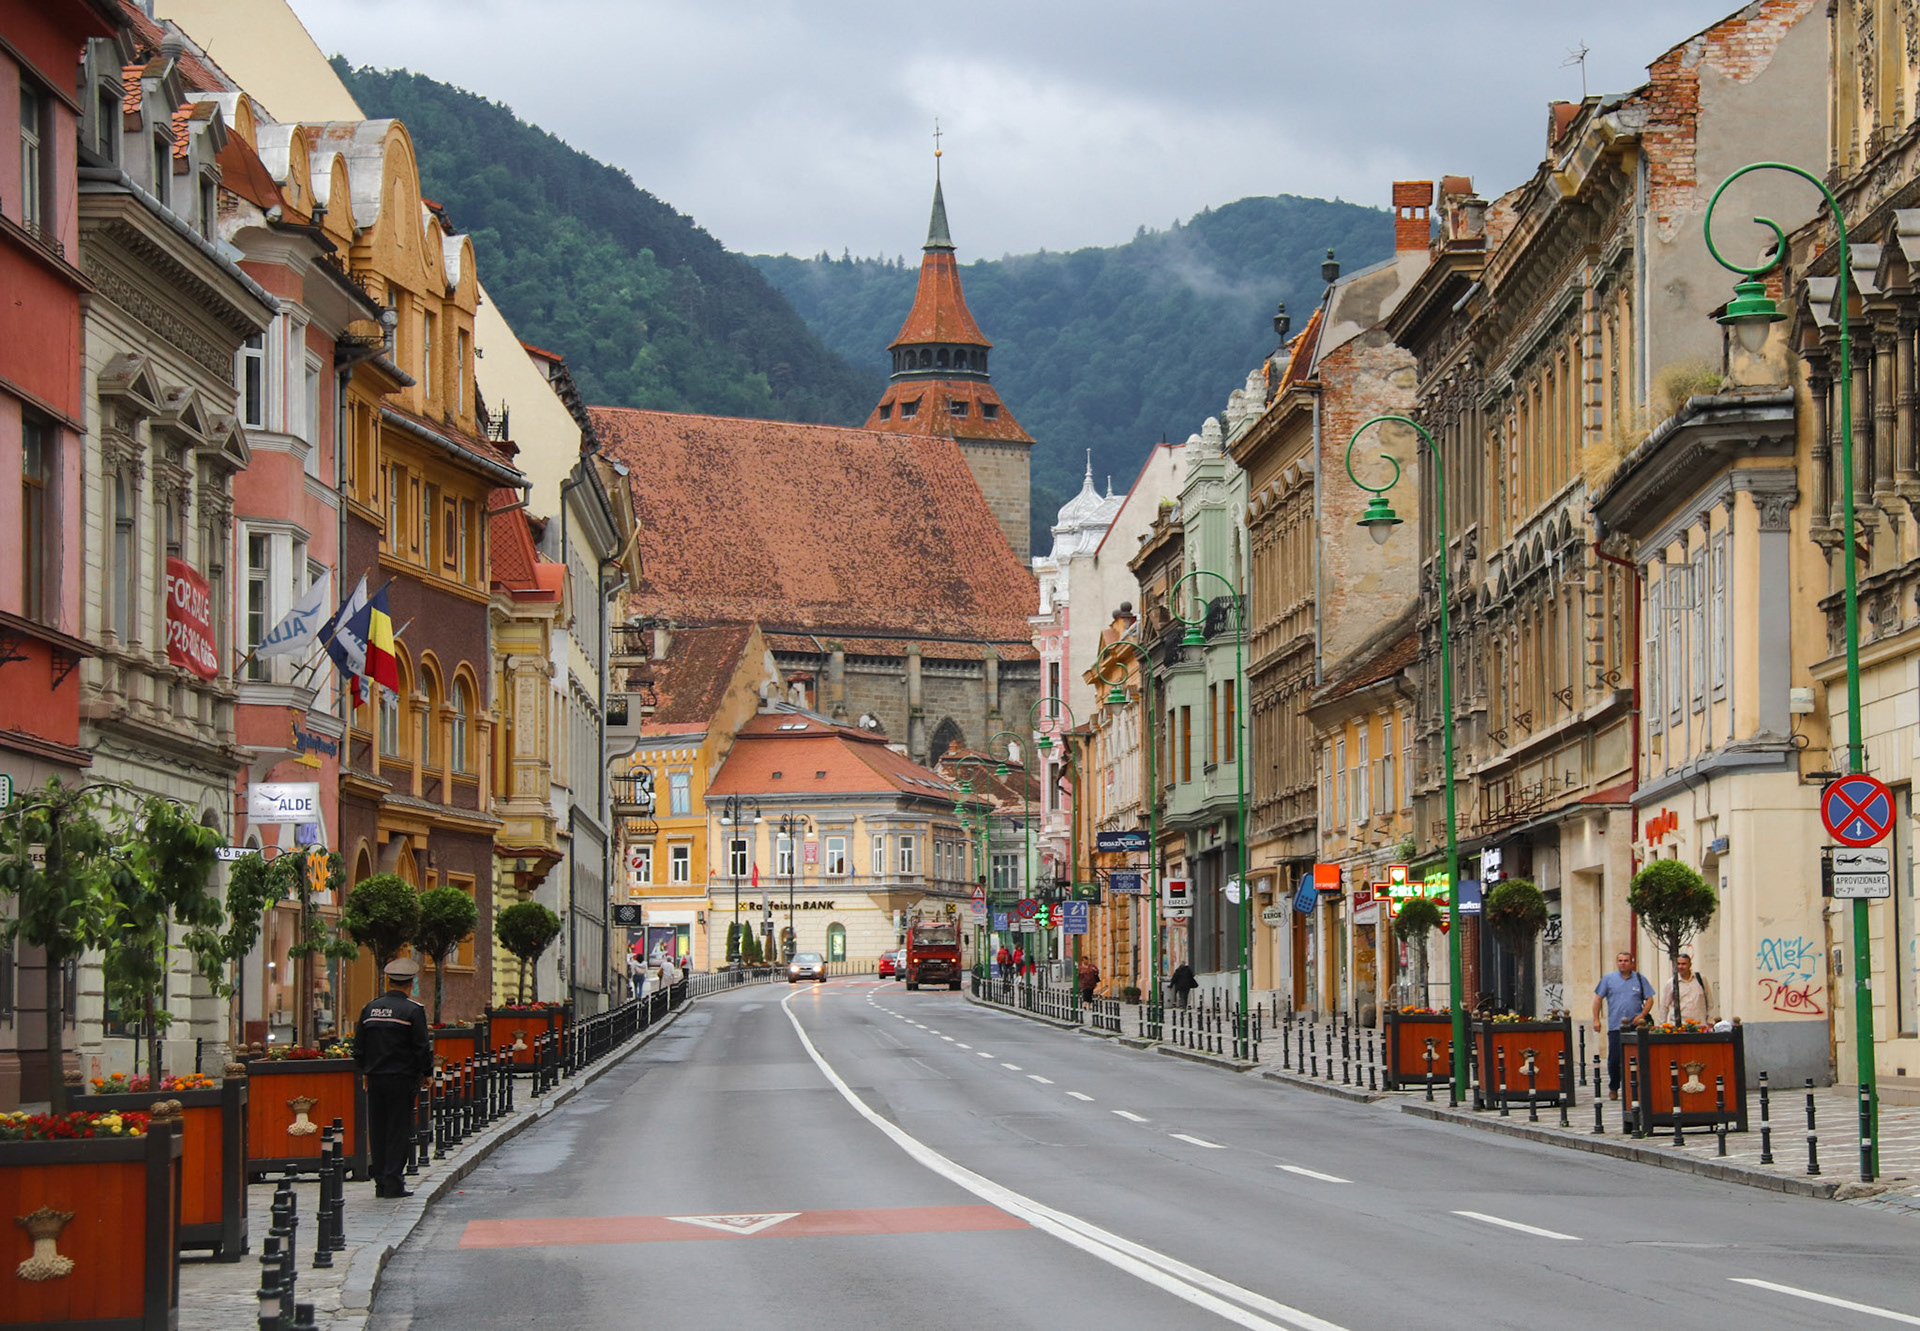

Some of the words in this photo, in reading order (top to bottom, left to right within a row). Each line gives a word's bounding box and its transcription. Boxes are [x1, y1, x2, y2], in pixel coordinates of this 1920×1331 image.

[166, 574, 191, 613] FOR
[191, 587, 210, 627] SALE
[279, 798, 313, 811] ALDE
[1315, 881, 1338, 889] orange
[1836, 876, 1887, 885] APROVIZIONARE
[803, 900, 835, 910] BANK
